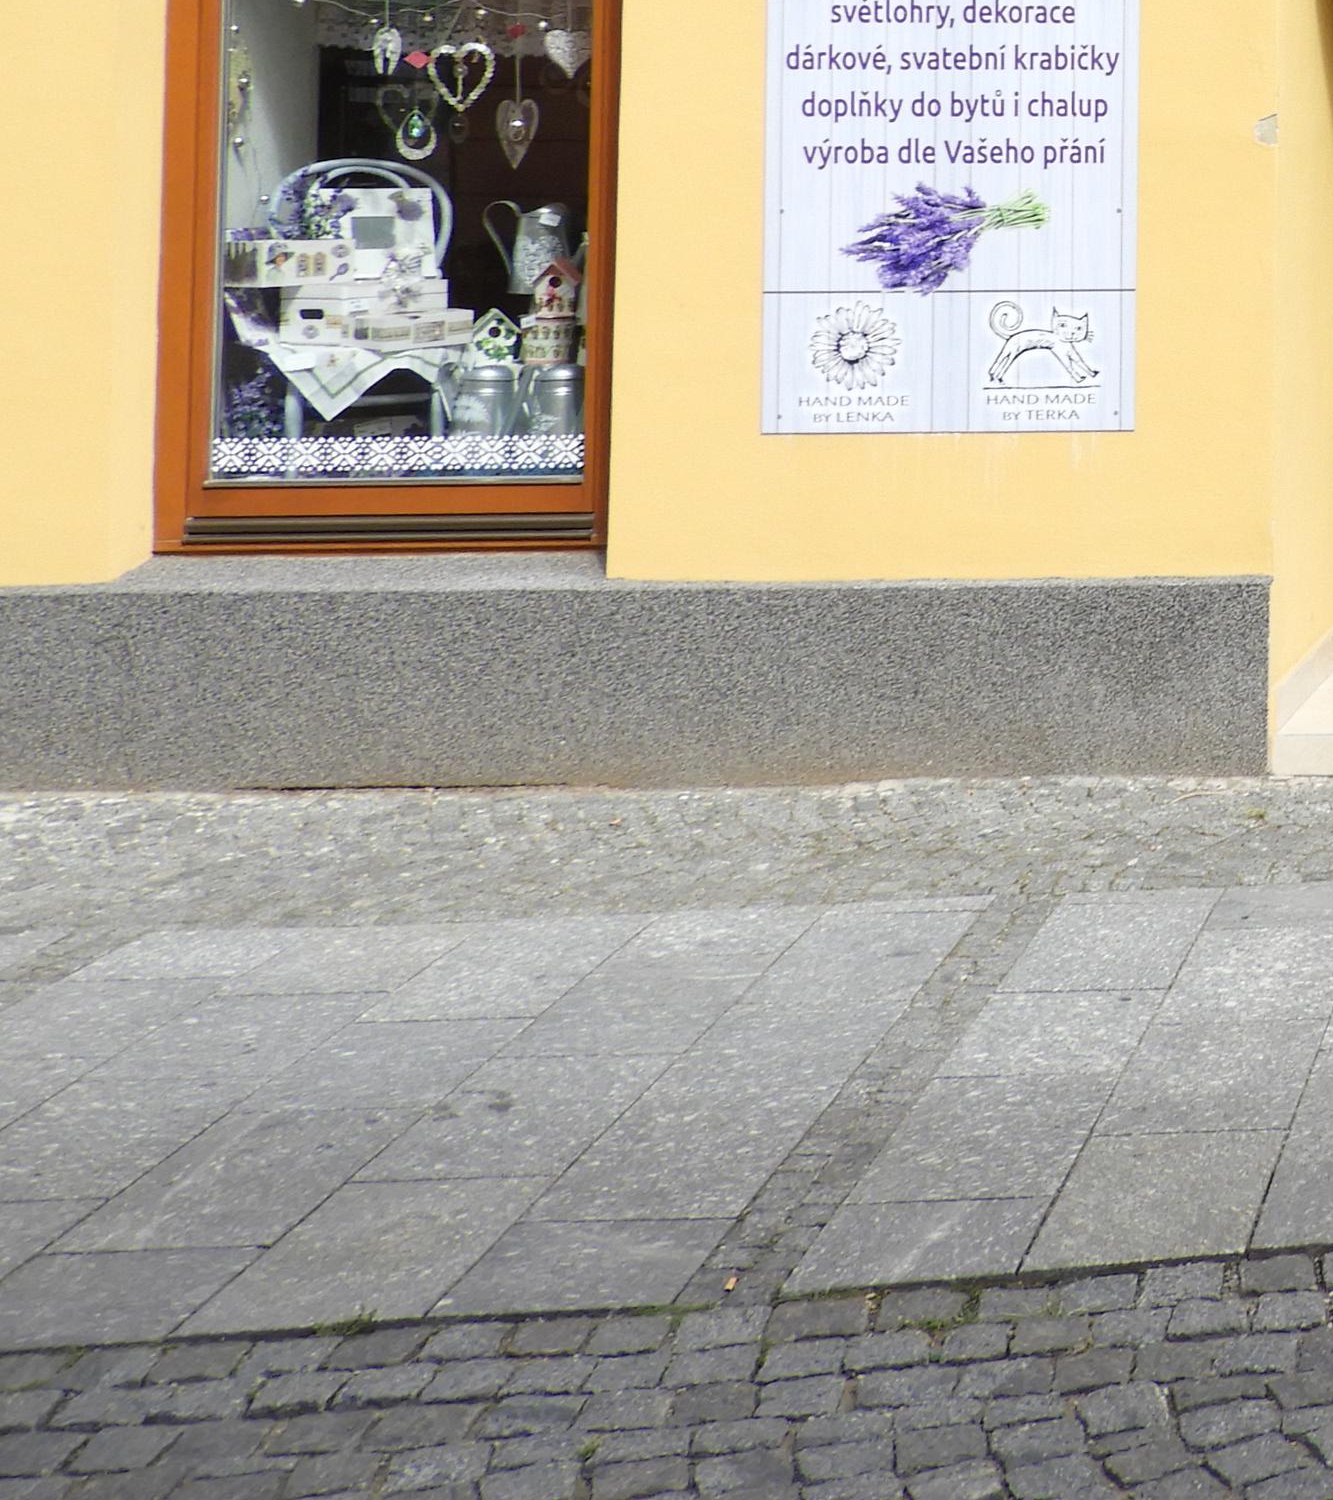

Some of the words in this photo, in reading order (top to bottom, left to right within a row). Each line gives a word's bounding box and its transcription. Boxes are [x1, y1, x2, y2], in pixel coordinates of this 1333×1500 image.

[963, 0, 1076, 23] dekorace
[786, 44, 892, 75] dárkové,
[900, 44, 1006, 70] svatební
[1013, 44, 1119, 76] krabičky
[802, 91, 903, 123] doplňky
[911, 91, 941, 117] do
[950, 89, 1004, 122] bytů
[1013, 91, 1020, 117] i
[1027, 91, 1108, 123] chalup
[803, 138, 889, 170] výroba
[898, 138, 936, 164] dle
[944, 138, 1035, 165] Vašeho
[1044, 138, 1106, 170] přání
[799, 396, 852, 406] HAND
[857, 395, 910, 406] MADE
[986, 394, 1039, 405] HAND
[1045, 393, 1096, 404] MADE
[813, 413, 832, 423] BY
[836, 412, 895, 423] LENKA
[1003, 412, 1021, 420] BY
[1025, 409, 1080, 420] TERKA
